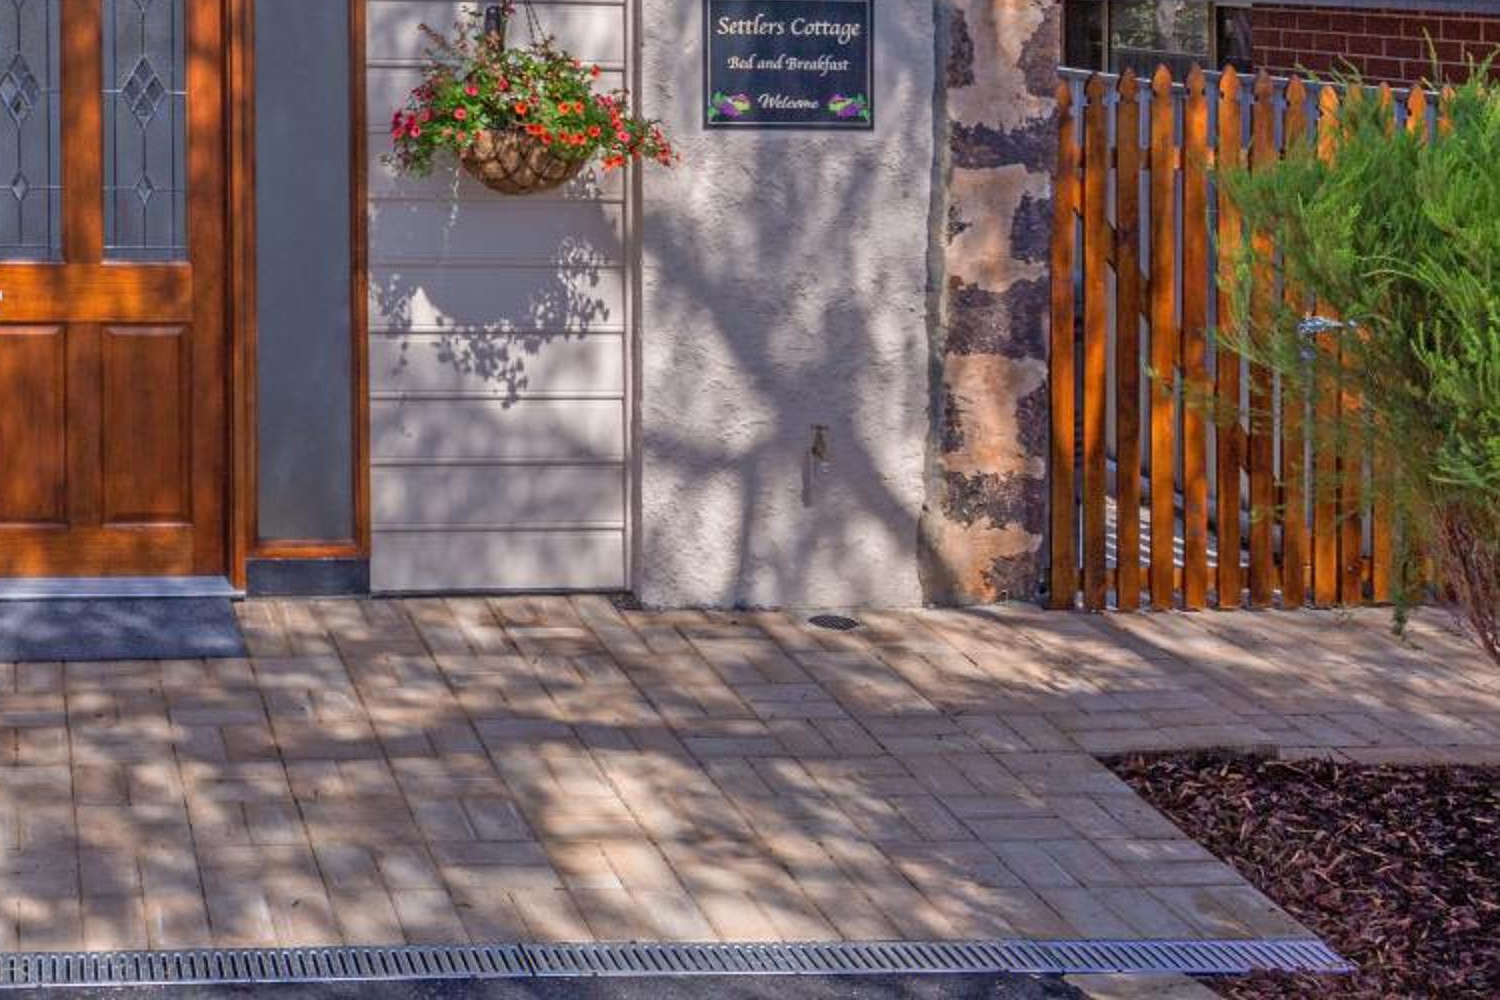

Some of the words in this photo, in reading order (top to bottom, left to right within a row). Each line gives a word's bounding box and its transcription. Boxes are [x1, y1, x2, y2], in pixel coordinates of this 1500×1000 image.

[717, 13, 785, 35] Settlers
[791, 17, 861, 45] Cottage
[728, 54, 756, 69] Bed
[757, 53, 786, 69] and
[786, 54, 850, 76] Breakfast
[758, 93, 819, 109] Welcome
